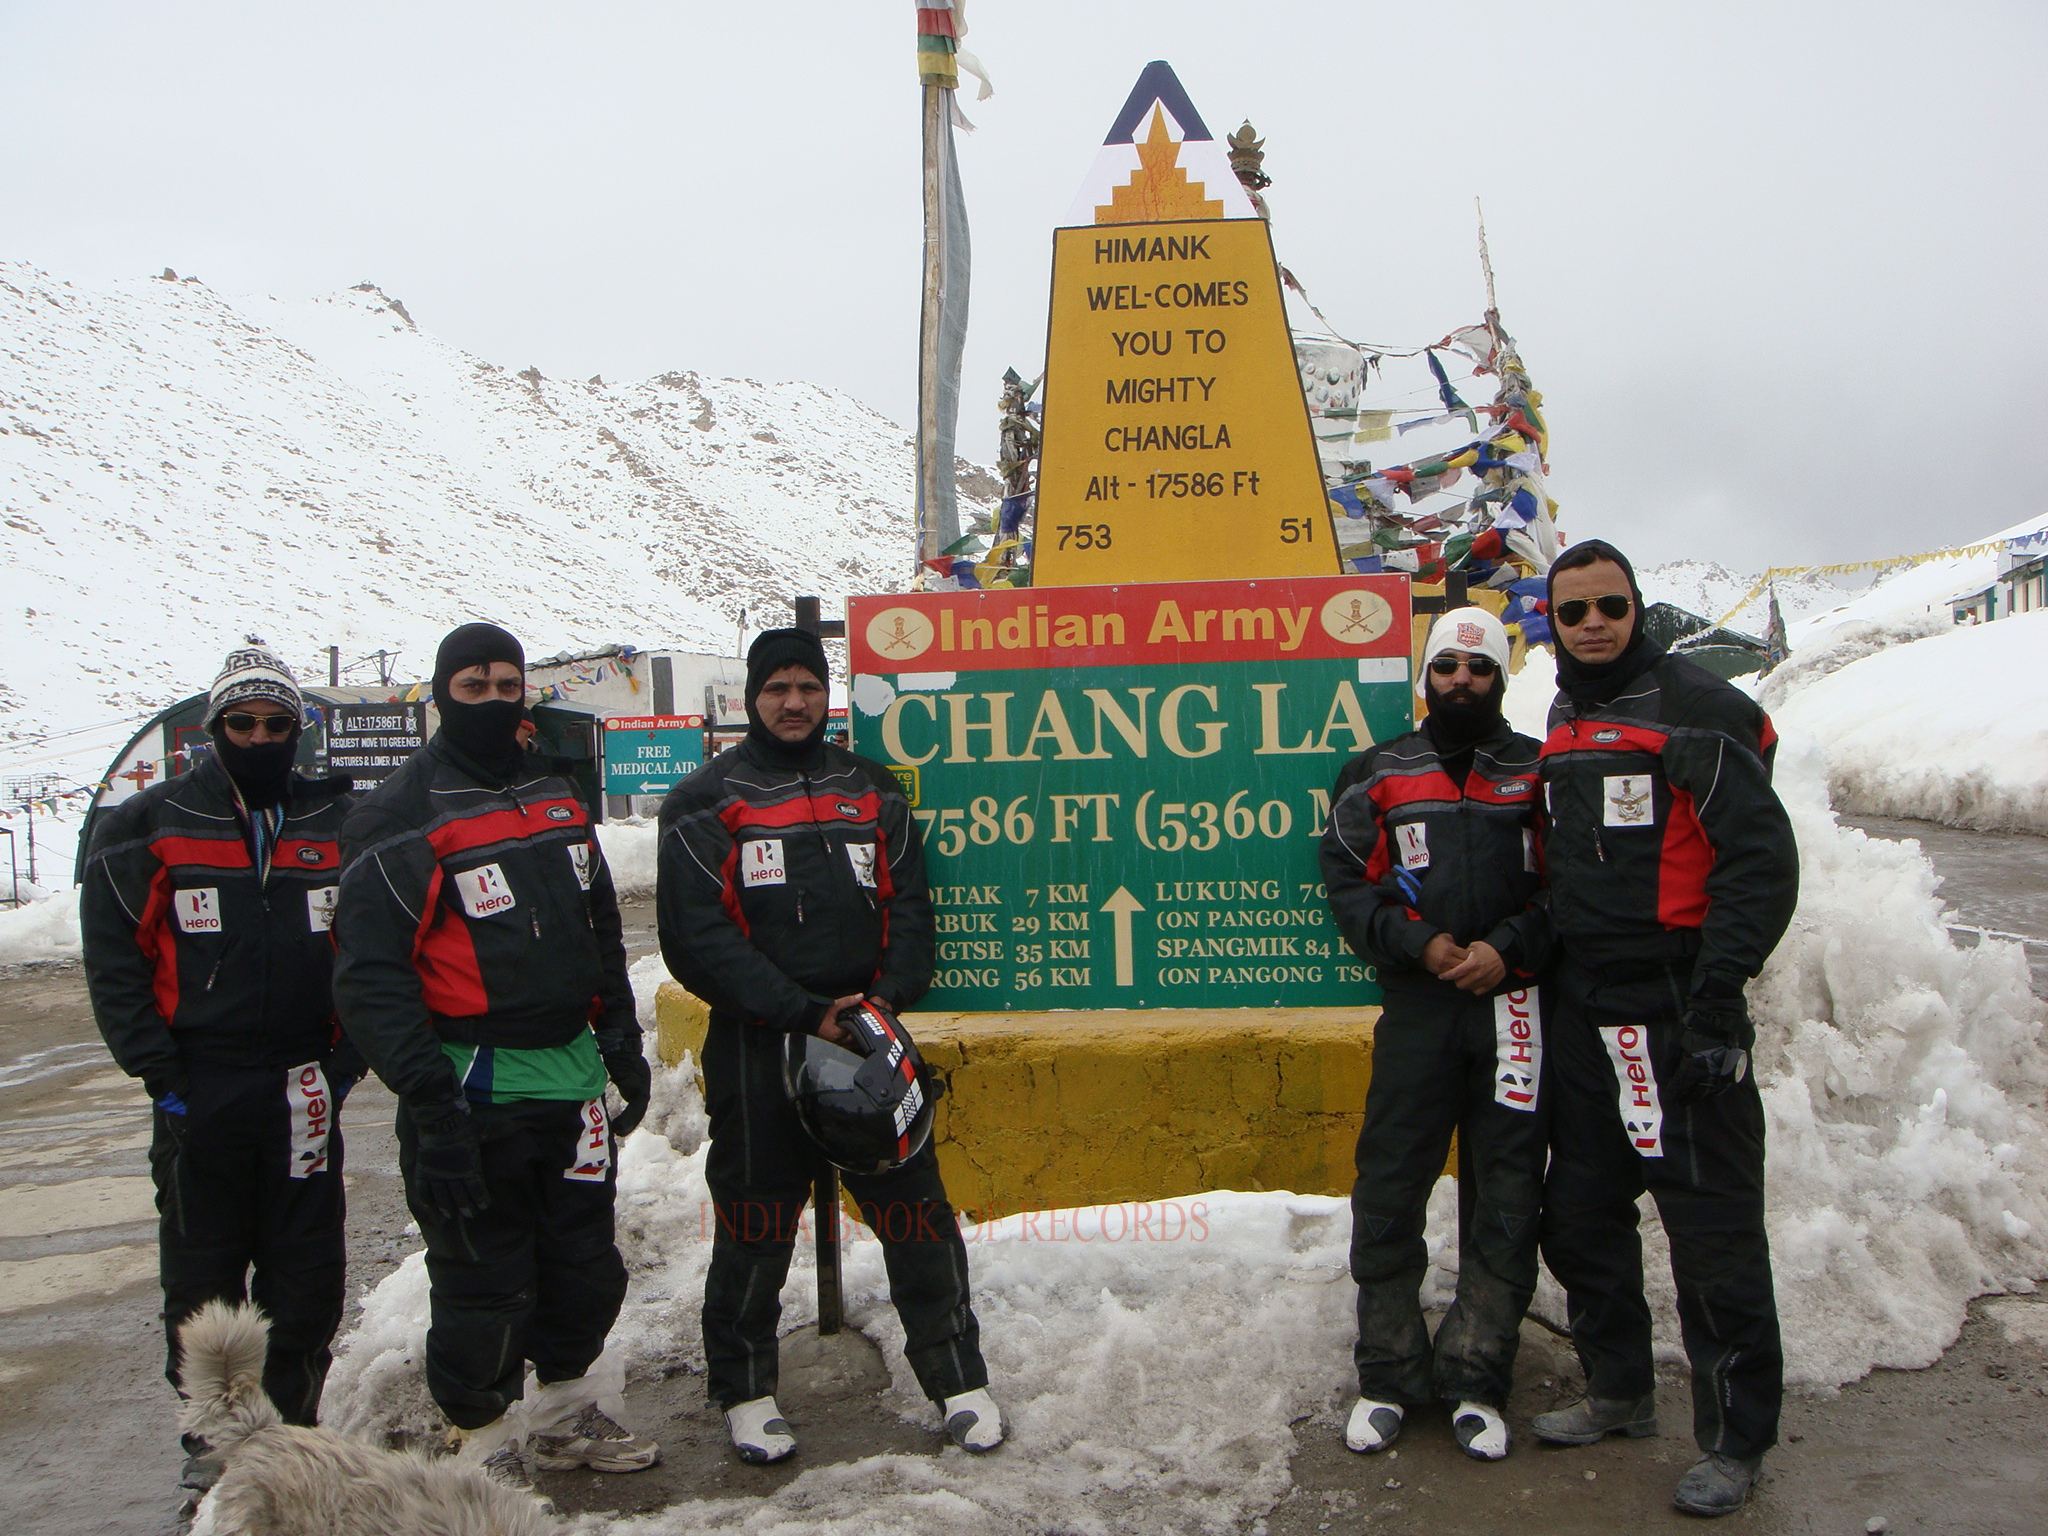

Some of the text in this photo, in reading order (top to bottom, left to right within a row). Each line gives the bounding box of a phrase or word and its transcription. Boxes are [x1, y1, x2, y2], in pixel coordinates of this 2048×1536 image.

[1094, 235, 1211, 264] HIMANK
[1087, 281, 1249, 311] WEL-COMES
[1112, 329, 1226, 356] YOU TO
[1106, 377, 1217, 404] MIGHTY
[1104, 424, 1231, 452] CHANGLA
[1085, 475, 1120, 501] Alt
[1146, 472, 1225, 499] 17586
[1233, 471, 1260, 496] Ft
[1056, 524, 1112, 550] 753
[1280, 518, 1313, 544] 51
[940, 599, 1314, 652] Indian Army
[620, 718, 686, 729] Indian Army
[881, 680, 1377, 766] CHANG LA
[330, 737, 421, 748] REQUEST MOVE TO GREENER
[637, 745, 671, 758] FREE
[331, 756, 363, 767] PASTURES
[364, 756, 370, 766] &
[611, 761, 697, 776] MEDICAL AID
[1050, 793, 1120, 843] FT
[1135, 789, 1293, 852] (5360
[1407, 852, 1428, 865] Hero
[750, 867, 783, 881] Hero
[1026, 889, 1039, 908] 7
[1047, 884, 1089, 903] KM
[1156, 880, 1281, 902] LUKUNG
[475, 895, 512, 912] Hero
[185, 918, 219, 928] Hero
[1012, 916, 1041, 935] 29
[1048, 912, 1089, 931] KM
[1156, 911, 1200, 931] (ON
[1207, 909, 1324, 928] PANGONG
[935, 940, 1091, 964] GTSE 35 KM
[1157, 937, 1300, 958] SPANGMIK
[1304, 939, 1331, 959] 84
[1014, 967, 1043, 991] 56
[1050, 967, 1092, 987] KM
[1158, 967, 1201, 987] (ON
[1208, 966, 1323, 984] PANGONG
[1506, 988, 1533, 1064] Hero
[1617, 1026, 1652, 1108] Hero
[300, 1066, 327, 1139] Hero
